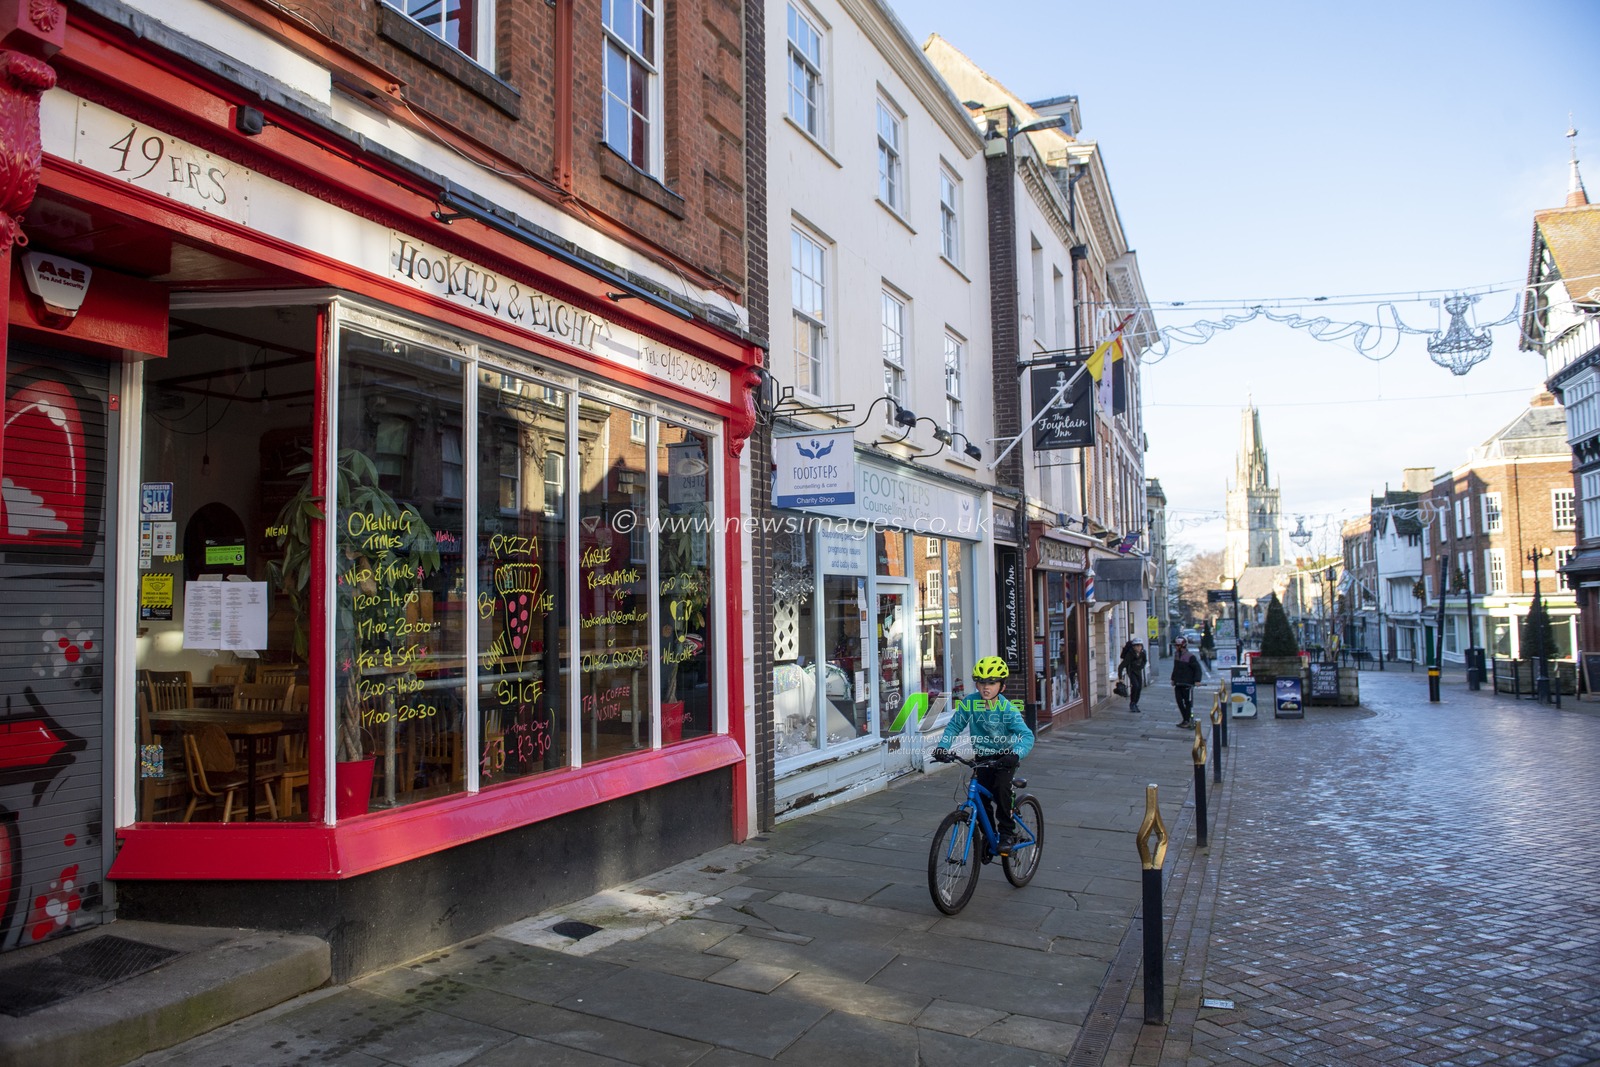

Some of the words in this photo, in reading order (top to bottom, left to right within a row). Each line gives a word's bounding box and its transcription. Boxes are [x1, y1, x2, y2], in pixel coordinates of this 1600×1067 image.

[109, 126, 228, 205] 49ERS
[38, 260, 85, 283] A&E
[63, 280, 84, 290] Security
[397, 238, 500, 315] HOOKER
[508, 283, 524, 320] &
[528, 292, 603, 350] EIGHT
[661, 351, 688, 381] 01452
[1038, 415, 1088, 431] Fountain
[1052, 412, 1064, 421] The
[1055, 430, 1072, 438] Inn
[793, 465, 837, 480] FOOTSTEPS
[143, 490, 169, 503] CITY
[863, 471, 930, 507] FOOTSTEPS
[143, 498, 169, 513] SAFE
[796, 497, 818, 505] Charity
[863, 496, 906, 521] Counselling
[909, 506, 914, 519] &
[915, 508, 930, 519] Care
[265, 525, 288, 538] MENU
[163, 553, 184, 563] MENU
[581, 546, 611, 569] TABLE
[1006, 564, 1015, 586] Inn
[533, 589, 554, 612] THE
[1006, 588, 1016, 636] Fountain
[397, 644, 419, 666] SAT
[1006, 638, 1017, 660] The
[582, 692, 597, 713] TEA
[606, 686, 630, 702] COFFEE
[595, 702, 620, 721] NSIDE!
